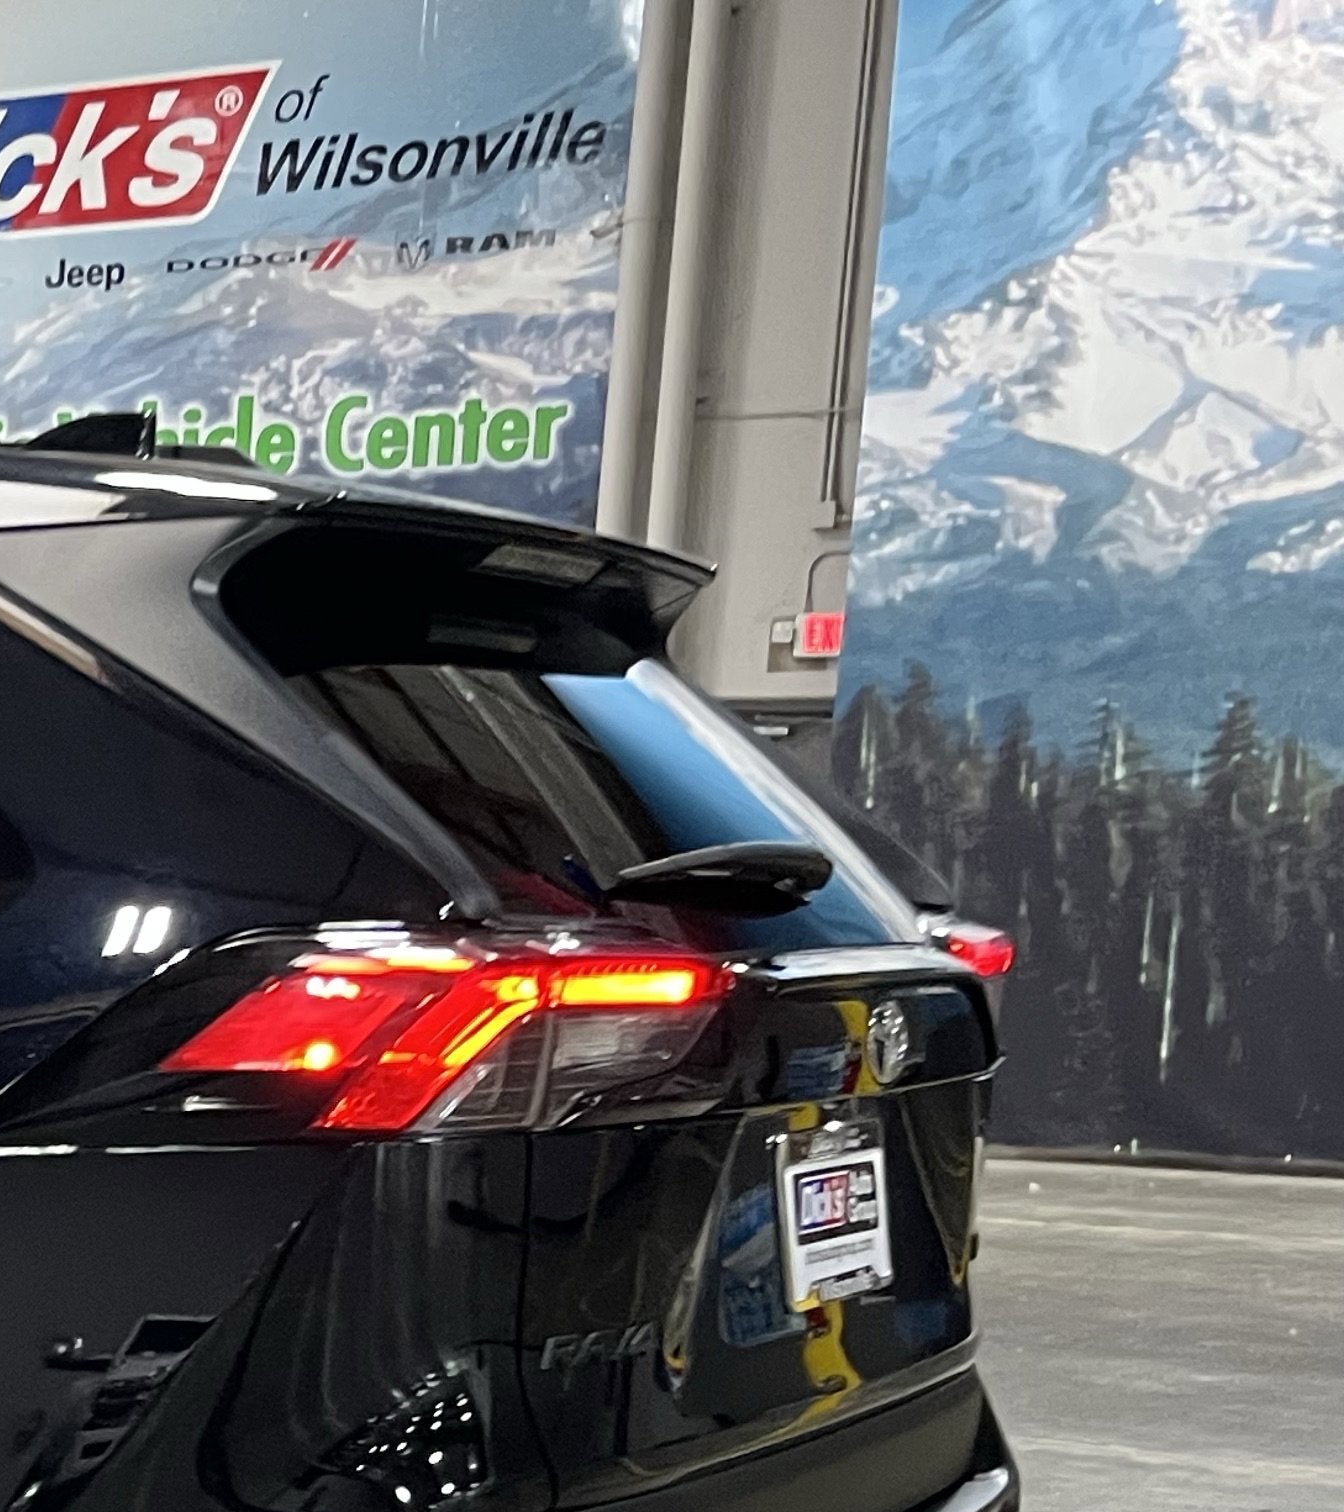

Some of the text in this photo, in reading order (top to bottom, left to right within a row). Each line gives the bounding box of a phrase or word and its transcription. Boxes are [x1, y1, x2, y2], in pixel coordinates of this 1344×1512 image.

[274, 74, 330, 124] of
[256, 108, 607, 196] Wilsonville
[446, 229, 556, 254] RAM
[45, 259, 125, 291] Jeep
[325, 395, 568, 472] Center
